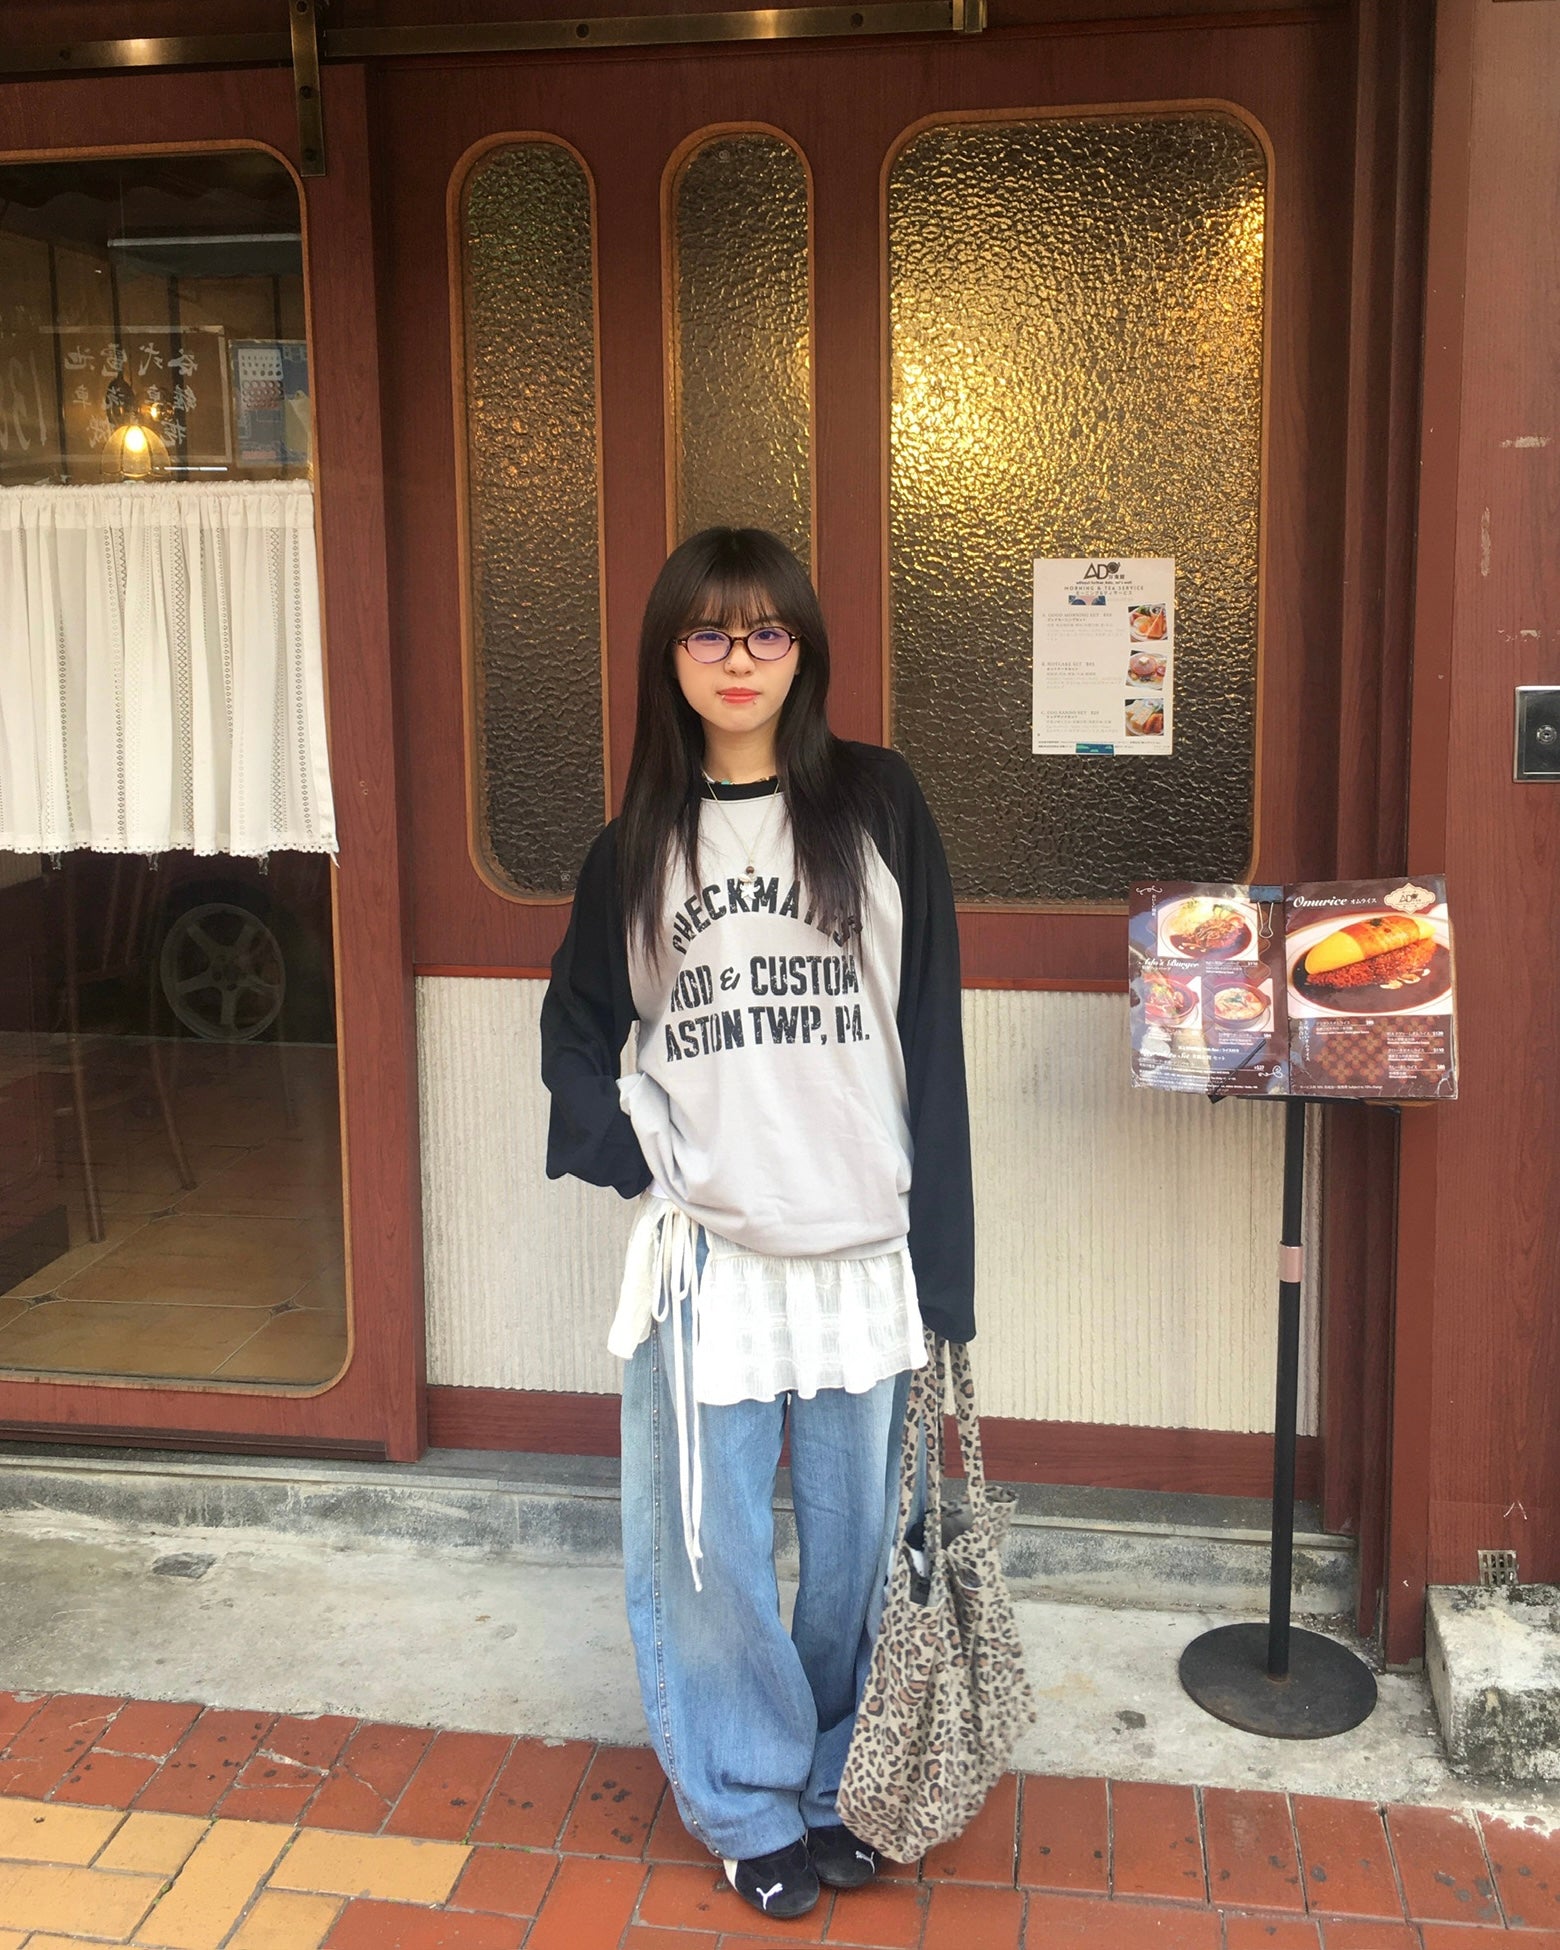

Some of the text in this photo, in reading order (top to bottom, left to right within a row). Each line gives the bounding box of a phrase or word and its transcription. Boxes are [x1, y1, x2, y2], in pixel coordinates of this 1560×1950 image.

[1293, 895, 1347, 908] Omurice
[720, 967, 741, 991] &
[750, 955, 859, 996] CUSTOM
[665, 1004, 870, 1062] ASTON TWP, PA.
